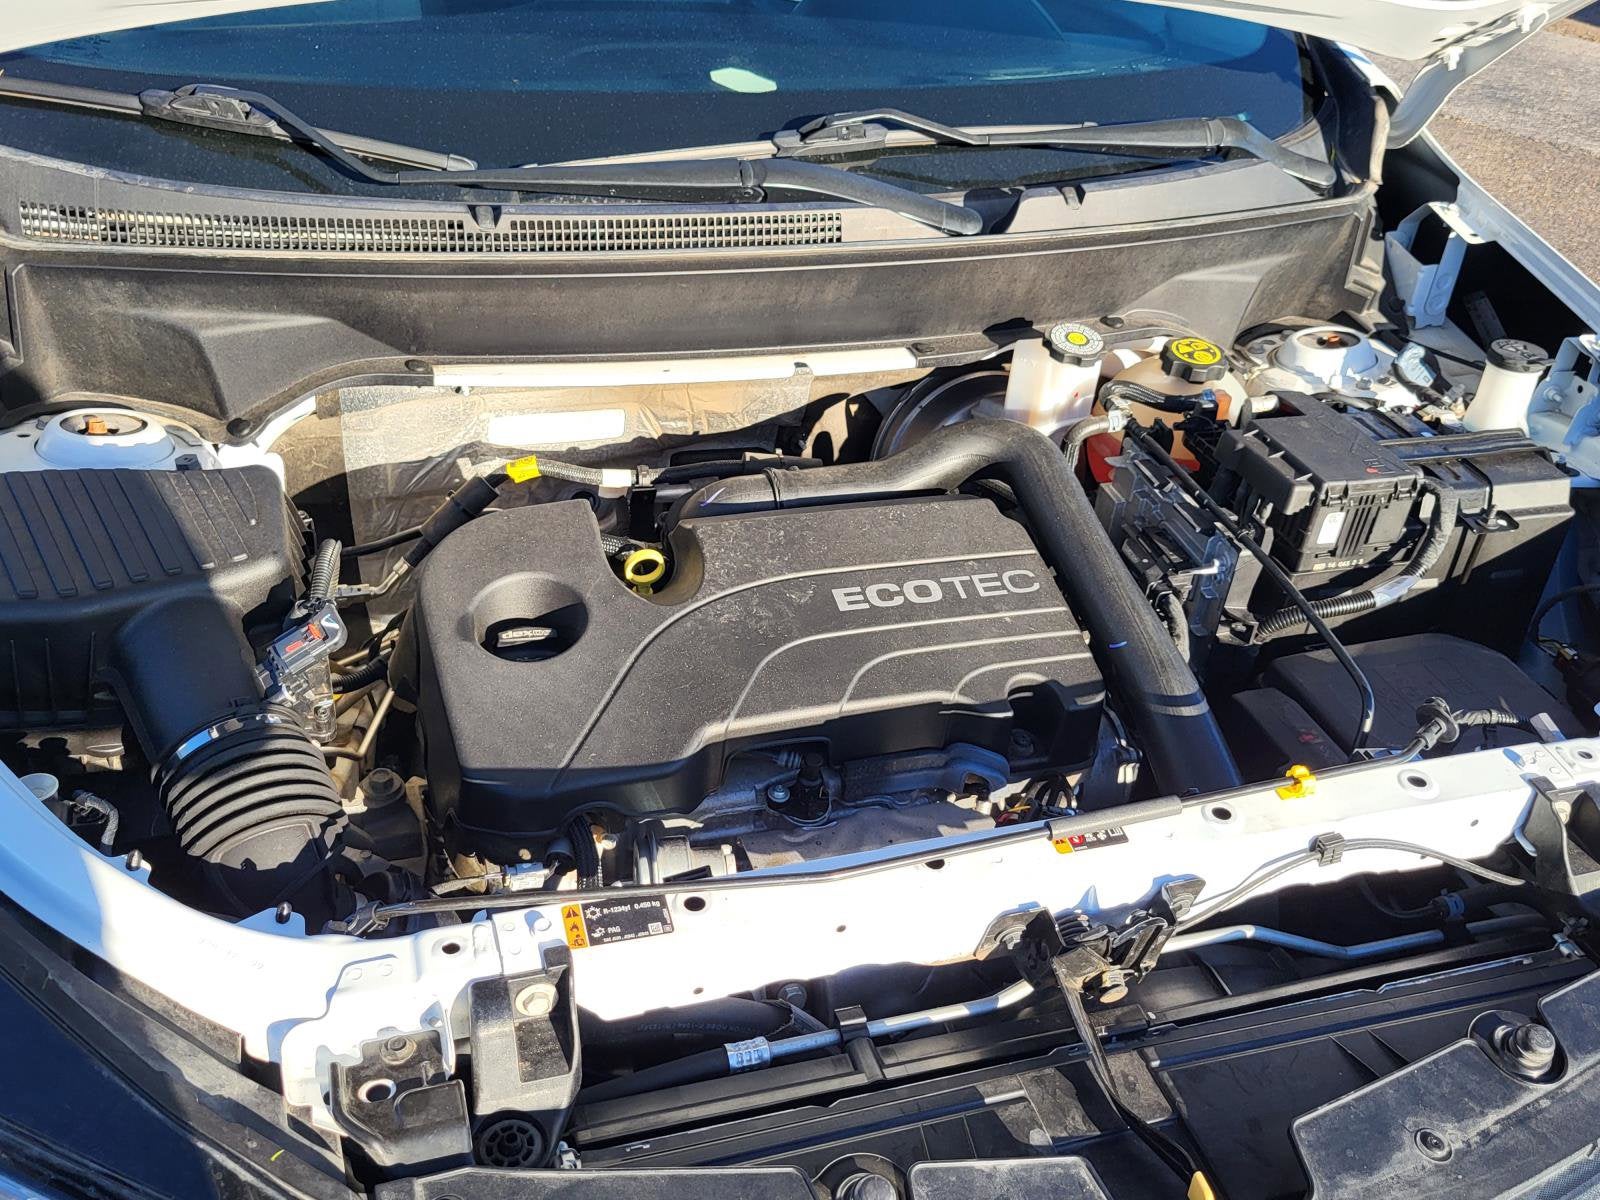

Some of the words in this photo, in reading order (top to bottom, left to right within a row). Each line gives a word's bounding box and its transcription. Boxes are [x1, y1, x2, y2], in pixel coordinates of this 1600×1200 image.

[831, 569, 1041, 612] ECOTEC
[652, 900, 660, 908] kg
[607, 925, 621, 934] PAG
